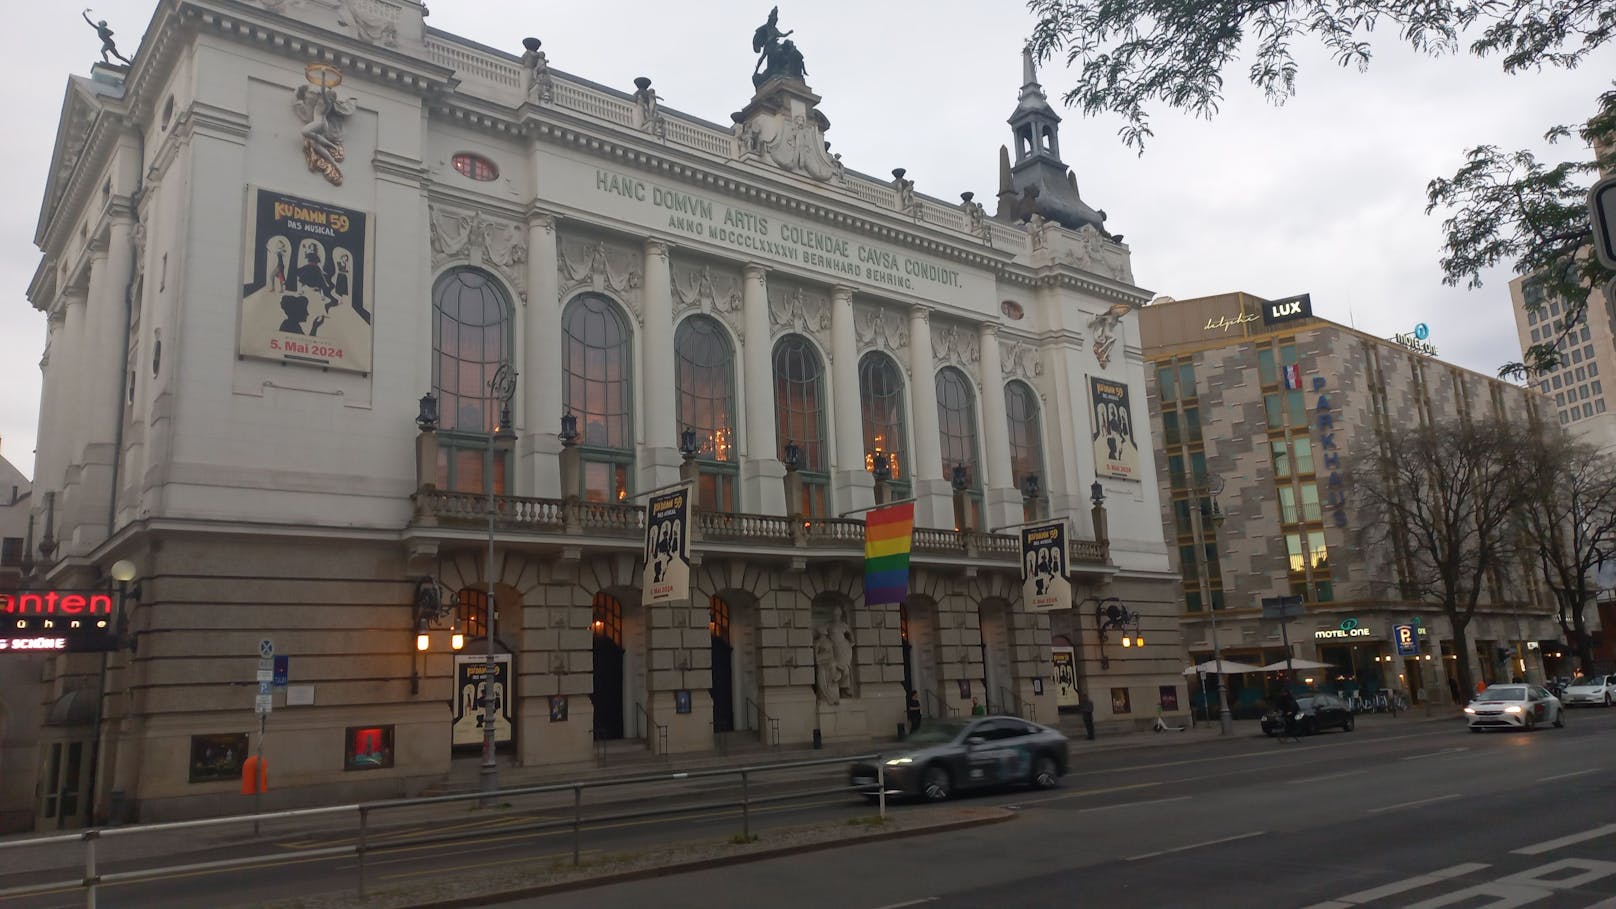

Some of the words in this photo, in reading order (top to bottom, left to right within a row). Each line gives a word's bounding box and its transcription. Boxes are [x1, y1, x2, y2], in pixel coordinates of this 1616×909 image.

[288, 219, 302, 230] DAS
[304, 223, 336, 237] MUSICAL
[329, 214, 350, 233] 59
[596, 170, 645, 201] HANC
[653, 187, 712, 221] DOMVM
[724, 208, 768, 236] ARTIS
[780, 224, 849, 258] COLENDAE
[858, 246, 899, 272] CAVSA
[905, 258, 962, 289] CONDIDIT.
[668, 215, 704, 235] ANNO
[709, 226, 798, 261] MDCCCLXXXXVI
[803, 252, 861, 277] BERNHARD
[1272, 301, 1302, 318] LUX
[270, 338, 281, 350] 5.
[284, 341, 309, 354] Mai
[311, 345, 343, 358] 2024
[1315, 630, 1348, 639] MOTEL
[1350, 628, 1370, 637] ONE
